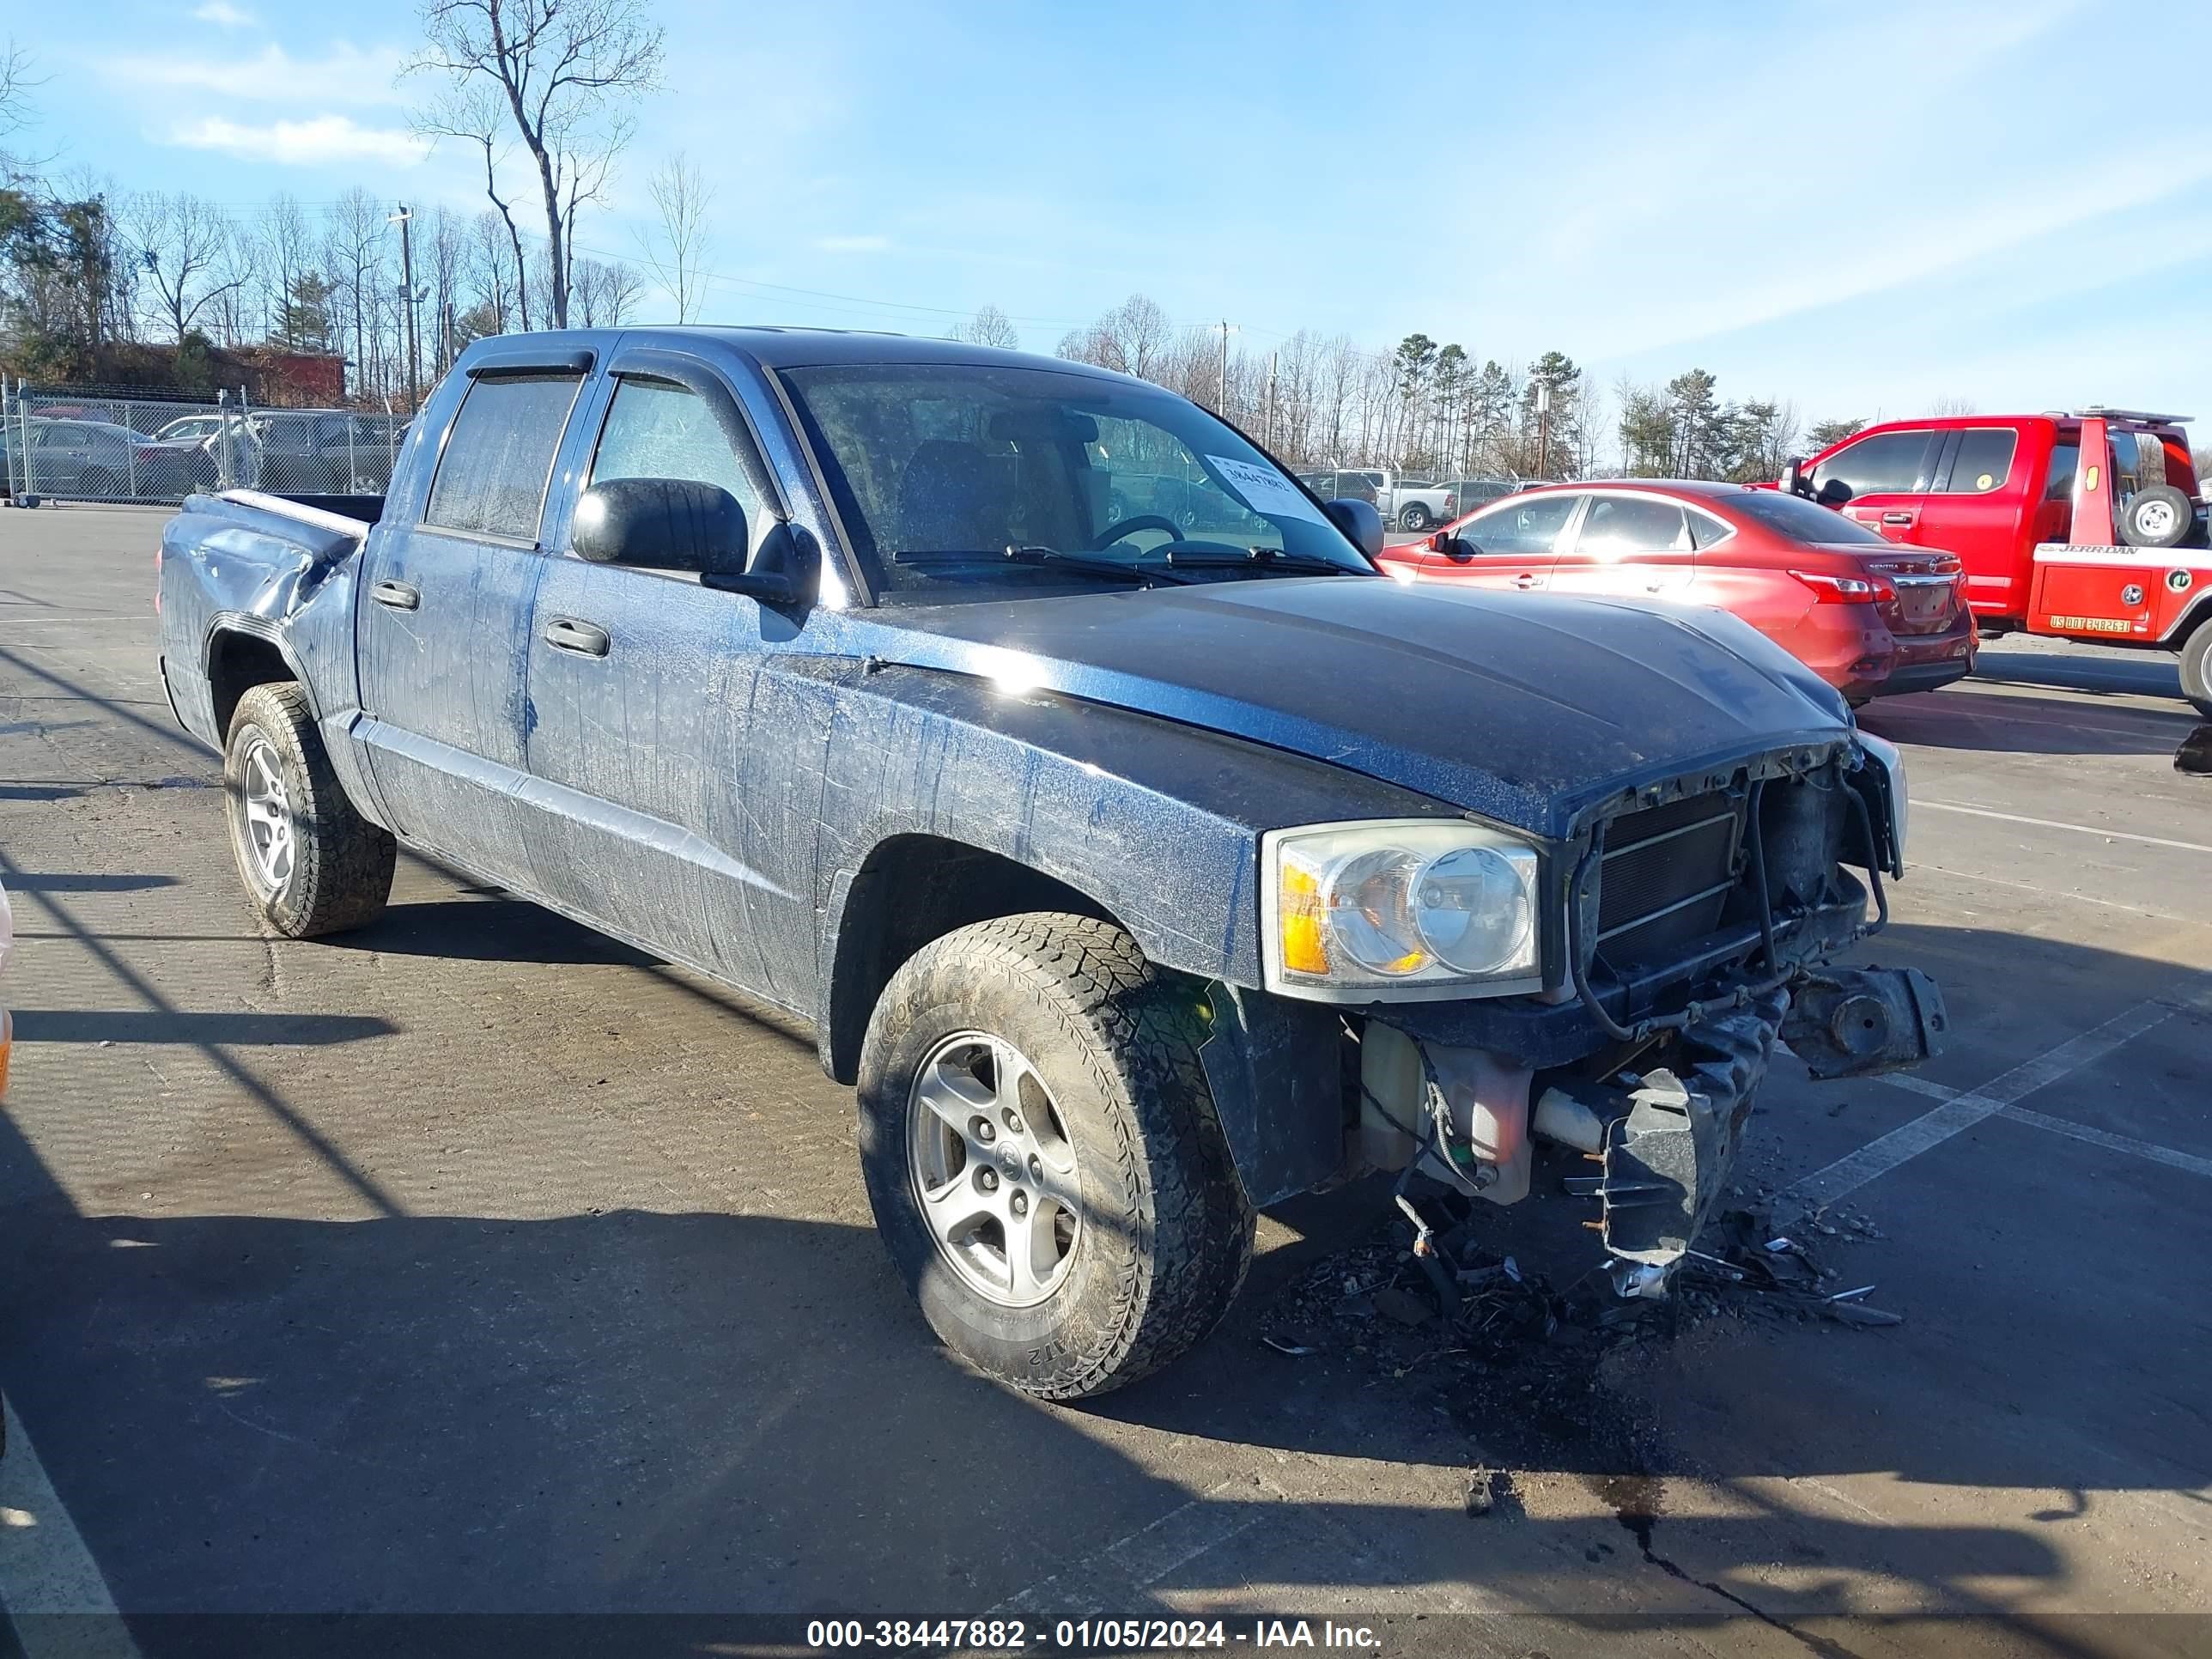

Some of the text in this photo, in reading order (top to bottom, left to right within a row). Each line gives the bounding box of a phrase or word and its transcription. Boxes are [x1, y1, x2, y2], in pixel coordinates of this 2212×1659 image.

[2051, 617, 2130, 632] US DOT 3482631
